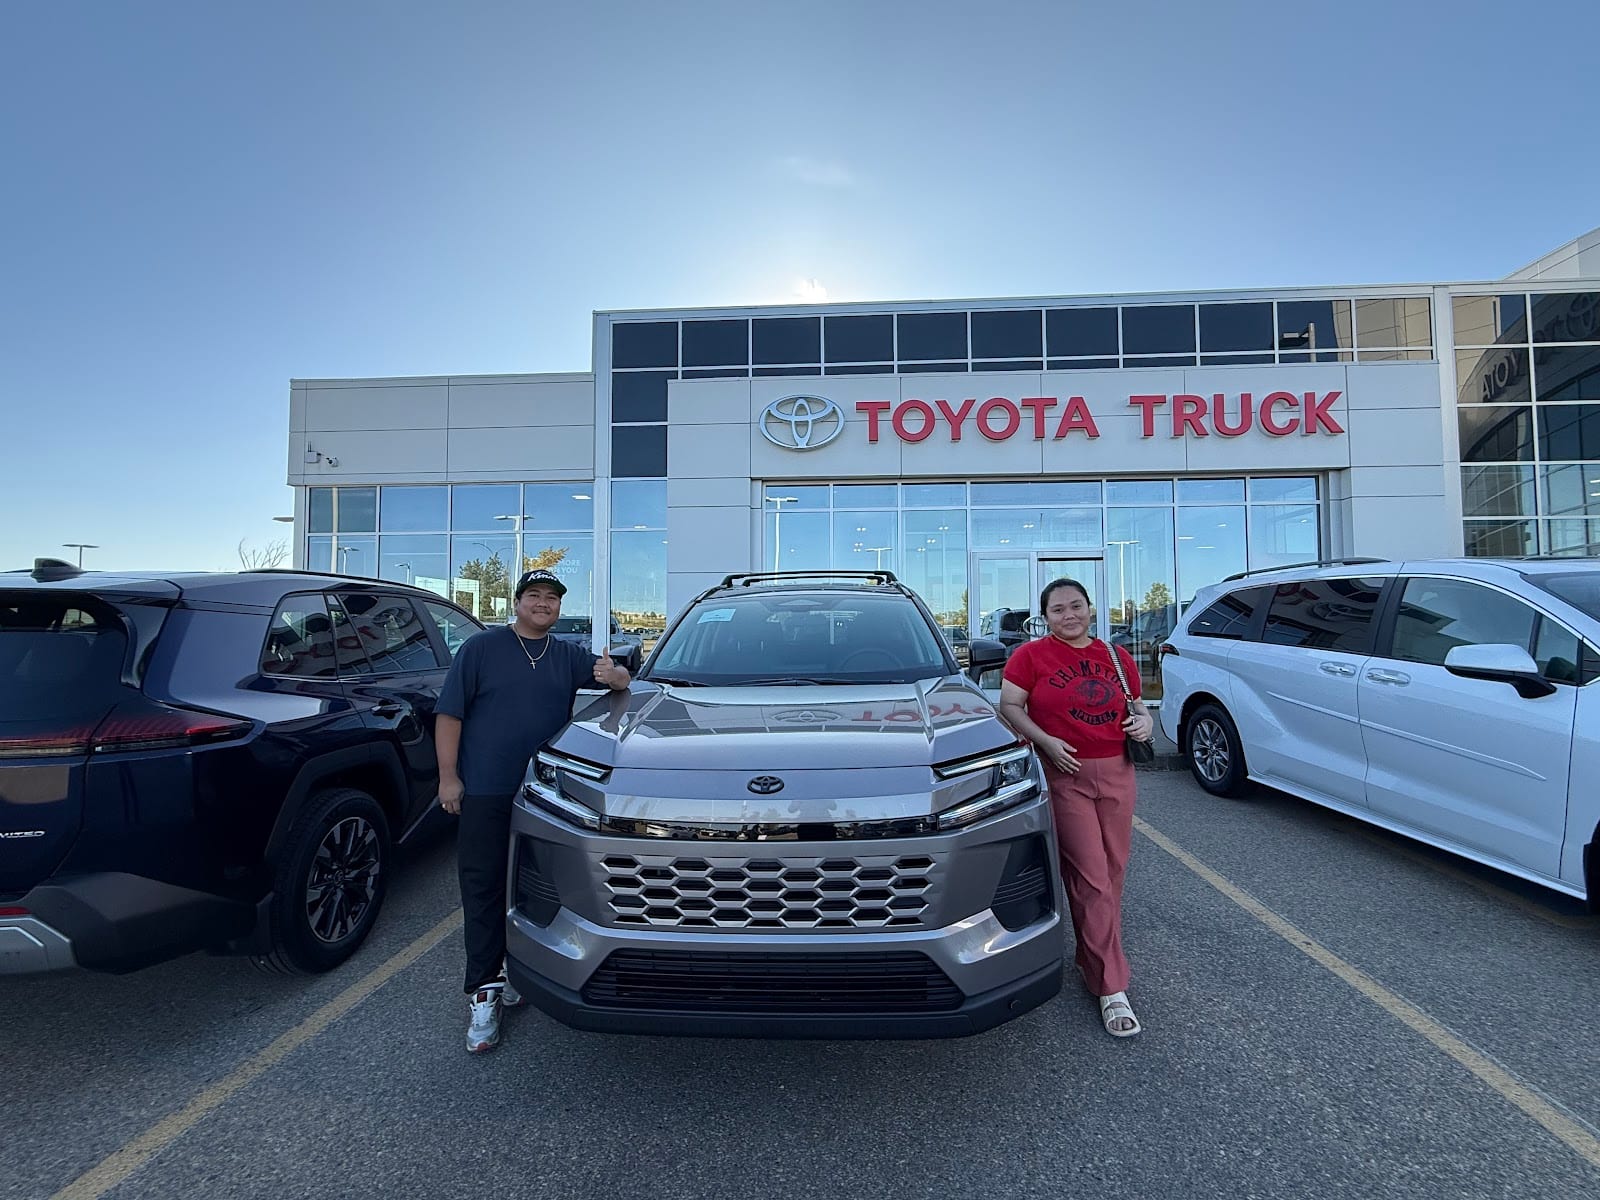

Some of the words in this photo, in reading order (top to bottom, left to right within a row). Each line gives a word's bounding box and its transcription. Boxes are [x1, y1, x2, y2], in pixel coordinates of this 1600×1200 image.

[856, 396, 1100, 443] TOYOTA
[1129, 391, 1345, 438] TRUCK
[1049, 659, 1122, 689] CHAMPIO
